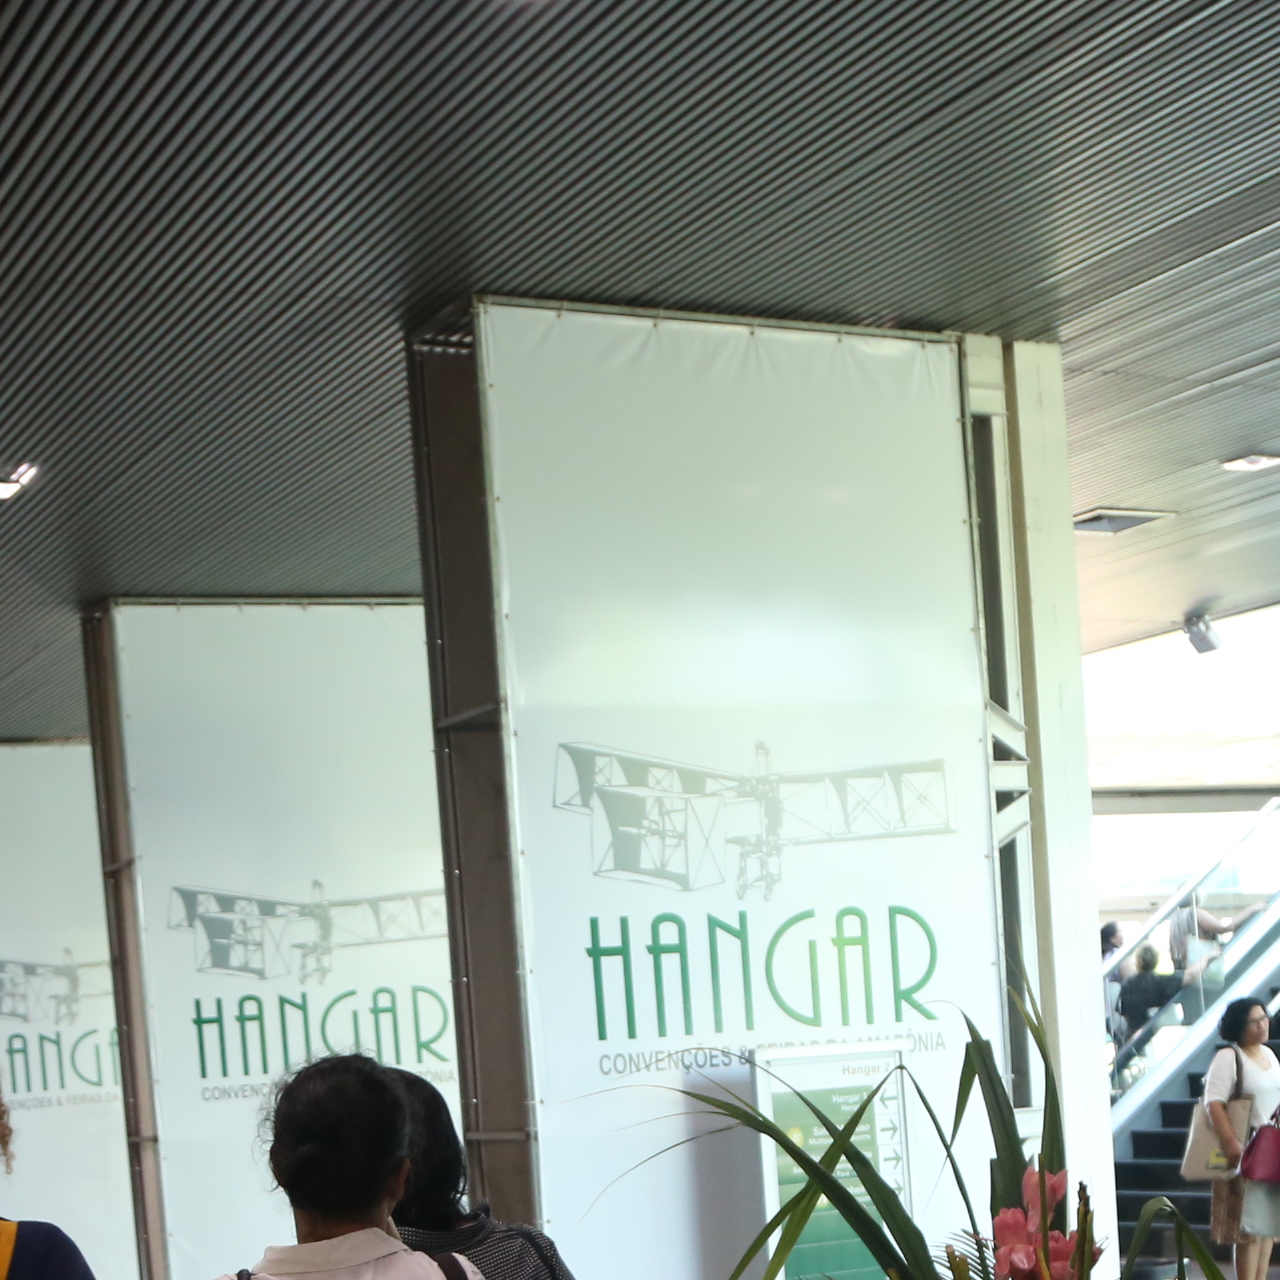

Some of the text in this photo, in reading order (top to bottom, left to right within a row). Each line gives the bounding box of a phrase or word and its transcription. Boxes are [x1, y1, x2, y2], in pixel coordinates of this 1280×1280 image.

[586, 904, 939, 1041] HANGAR
[192, 984, 451, 1078] HANGAR
[599, 1040, 733, 1076] CONVENÇÕES
[842, 1061, 891, 1077] Hangar 2
